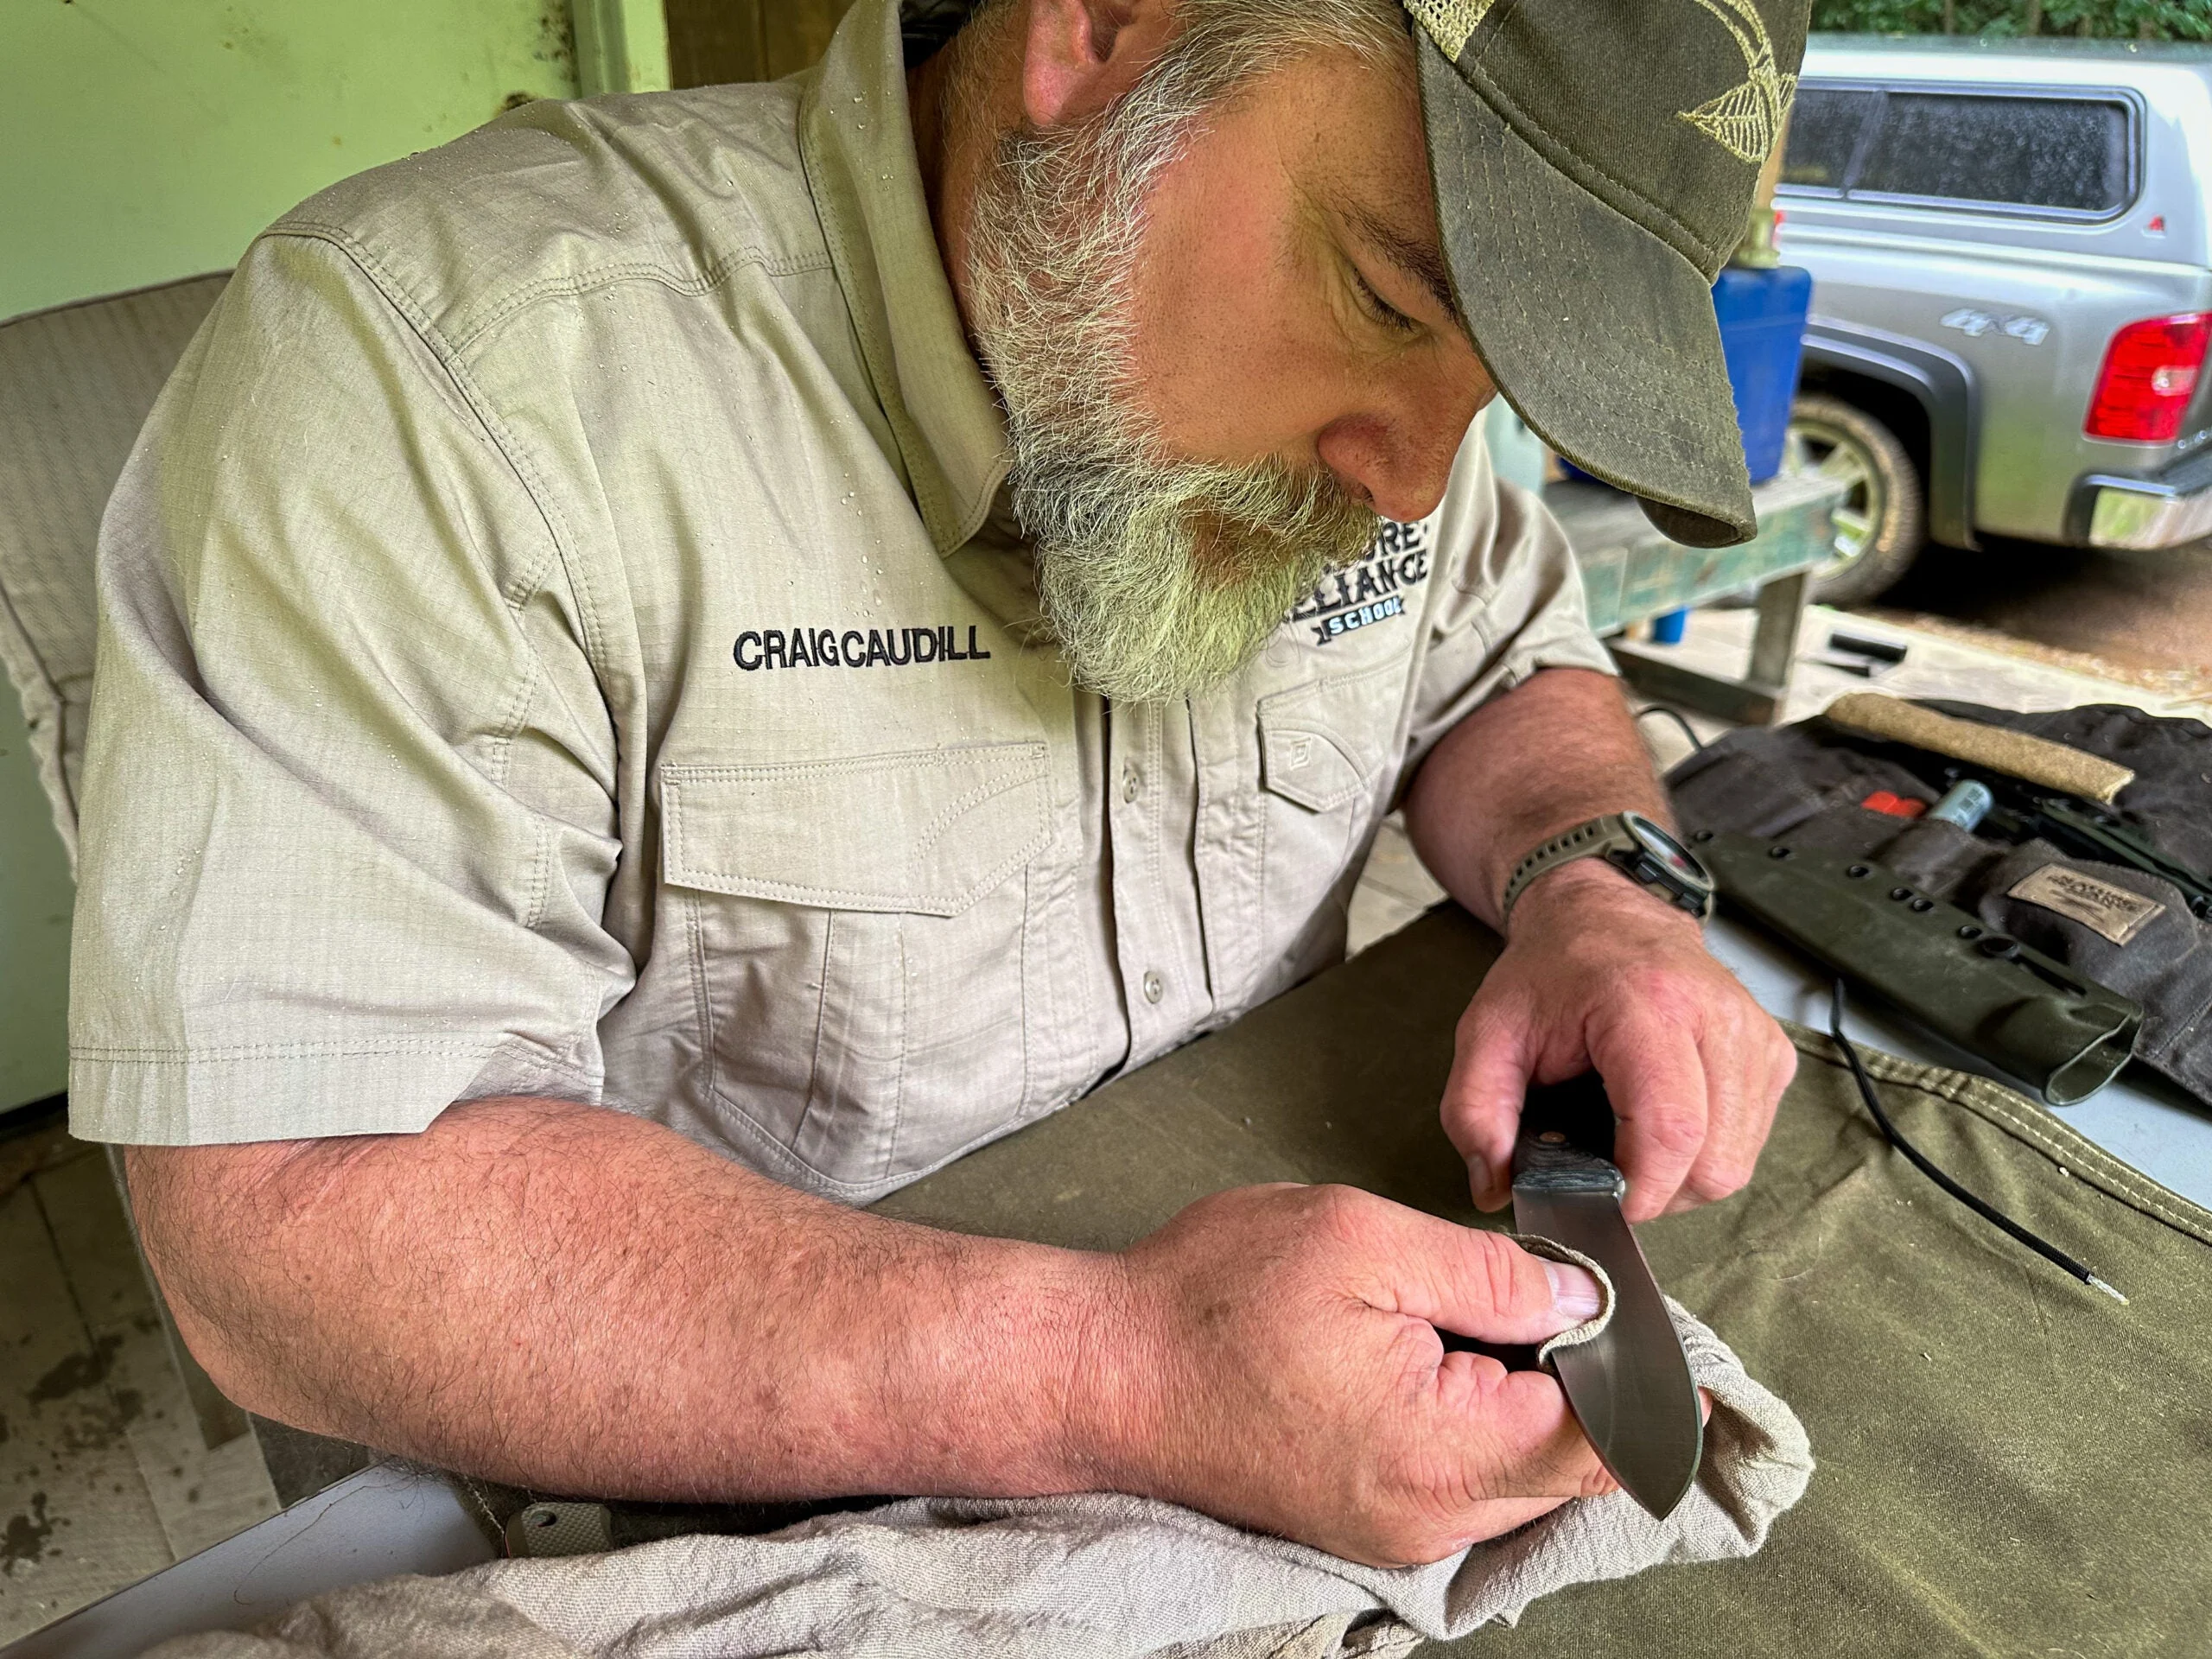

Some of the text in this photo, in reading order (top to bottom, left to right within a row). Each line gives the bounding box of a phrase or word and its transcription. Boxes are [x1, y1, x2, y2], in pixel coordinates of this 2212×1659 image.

[1291, 548, 1427, 621] LIANCE
[1328, 596, 1402, 635] SCHOOL
[734, 625, 991, 671] CRAIG CAUDILL
